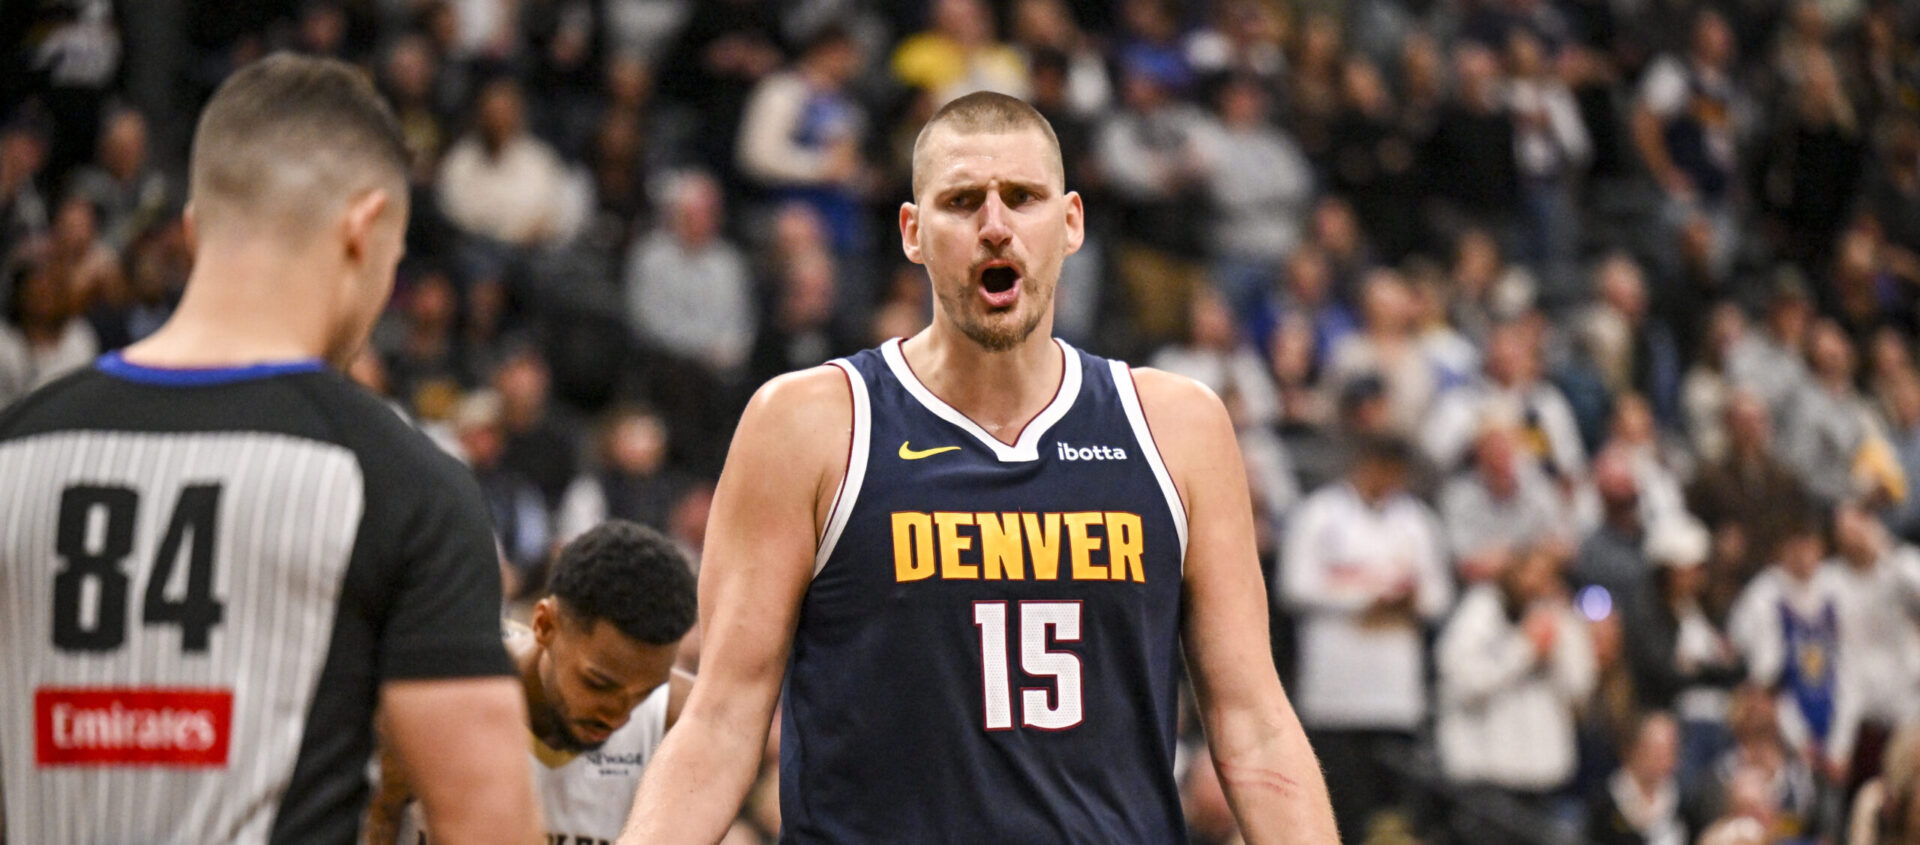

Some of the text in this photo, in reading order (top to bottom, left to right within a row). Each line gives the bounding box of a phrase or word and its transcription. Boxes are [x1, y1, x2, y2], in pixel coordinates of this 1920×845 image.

[1057, 441, 1128, 461] ibotta
[52, 482, 224, 654] 84
[890, 510, 1146, 583] DENVER
[972, 600, 1085, 732] 15
[51, 702, 216, 751] Emirates
